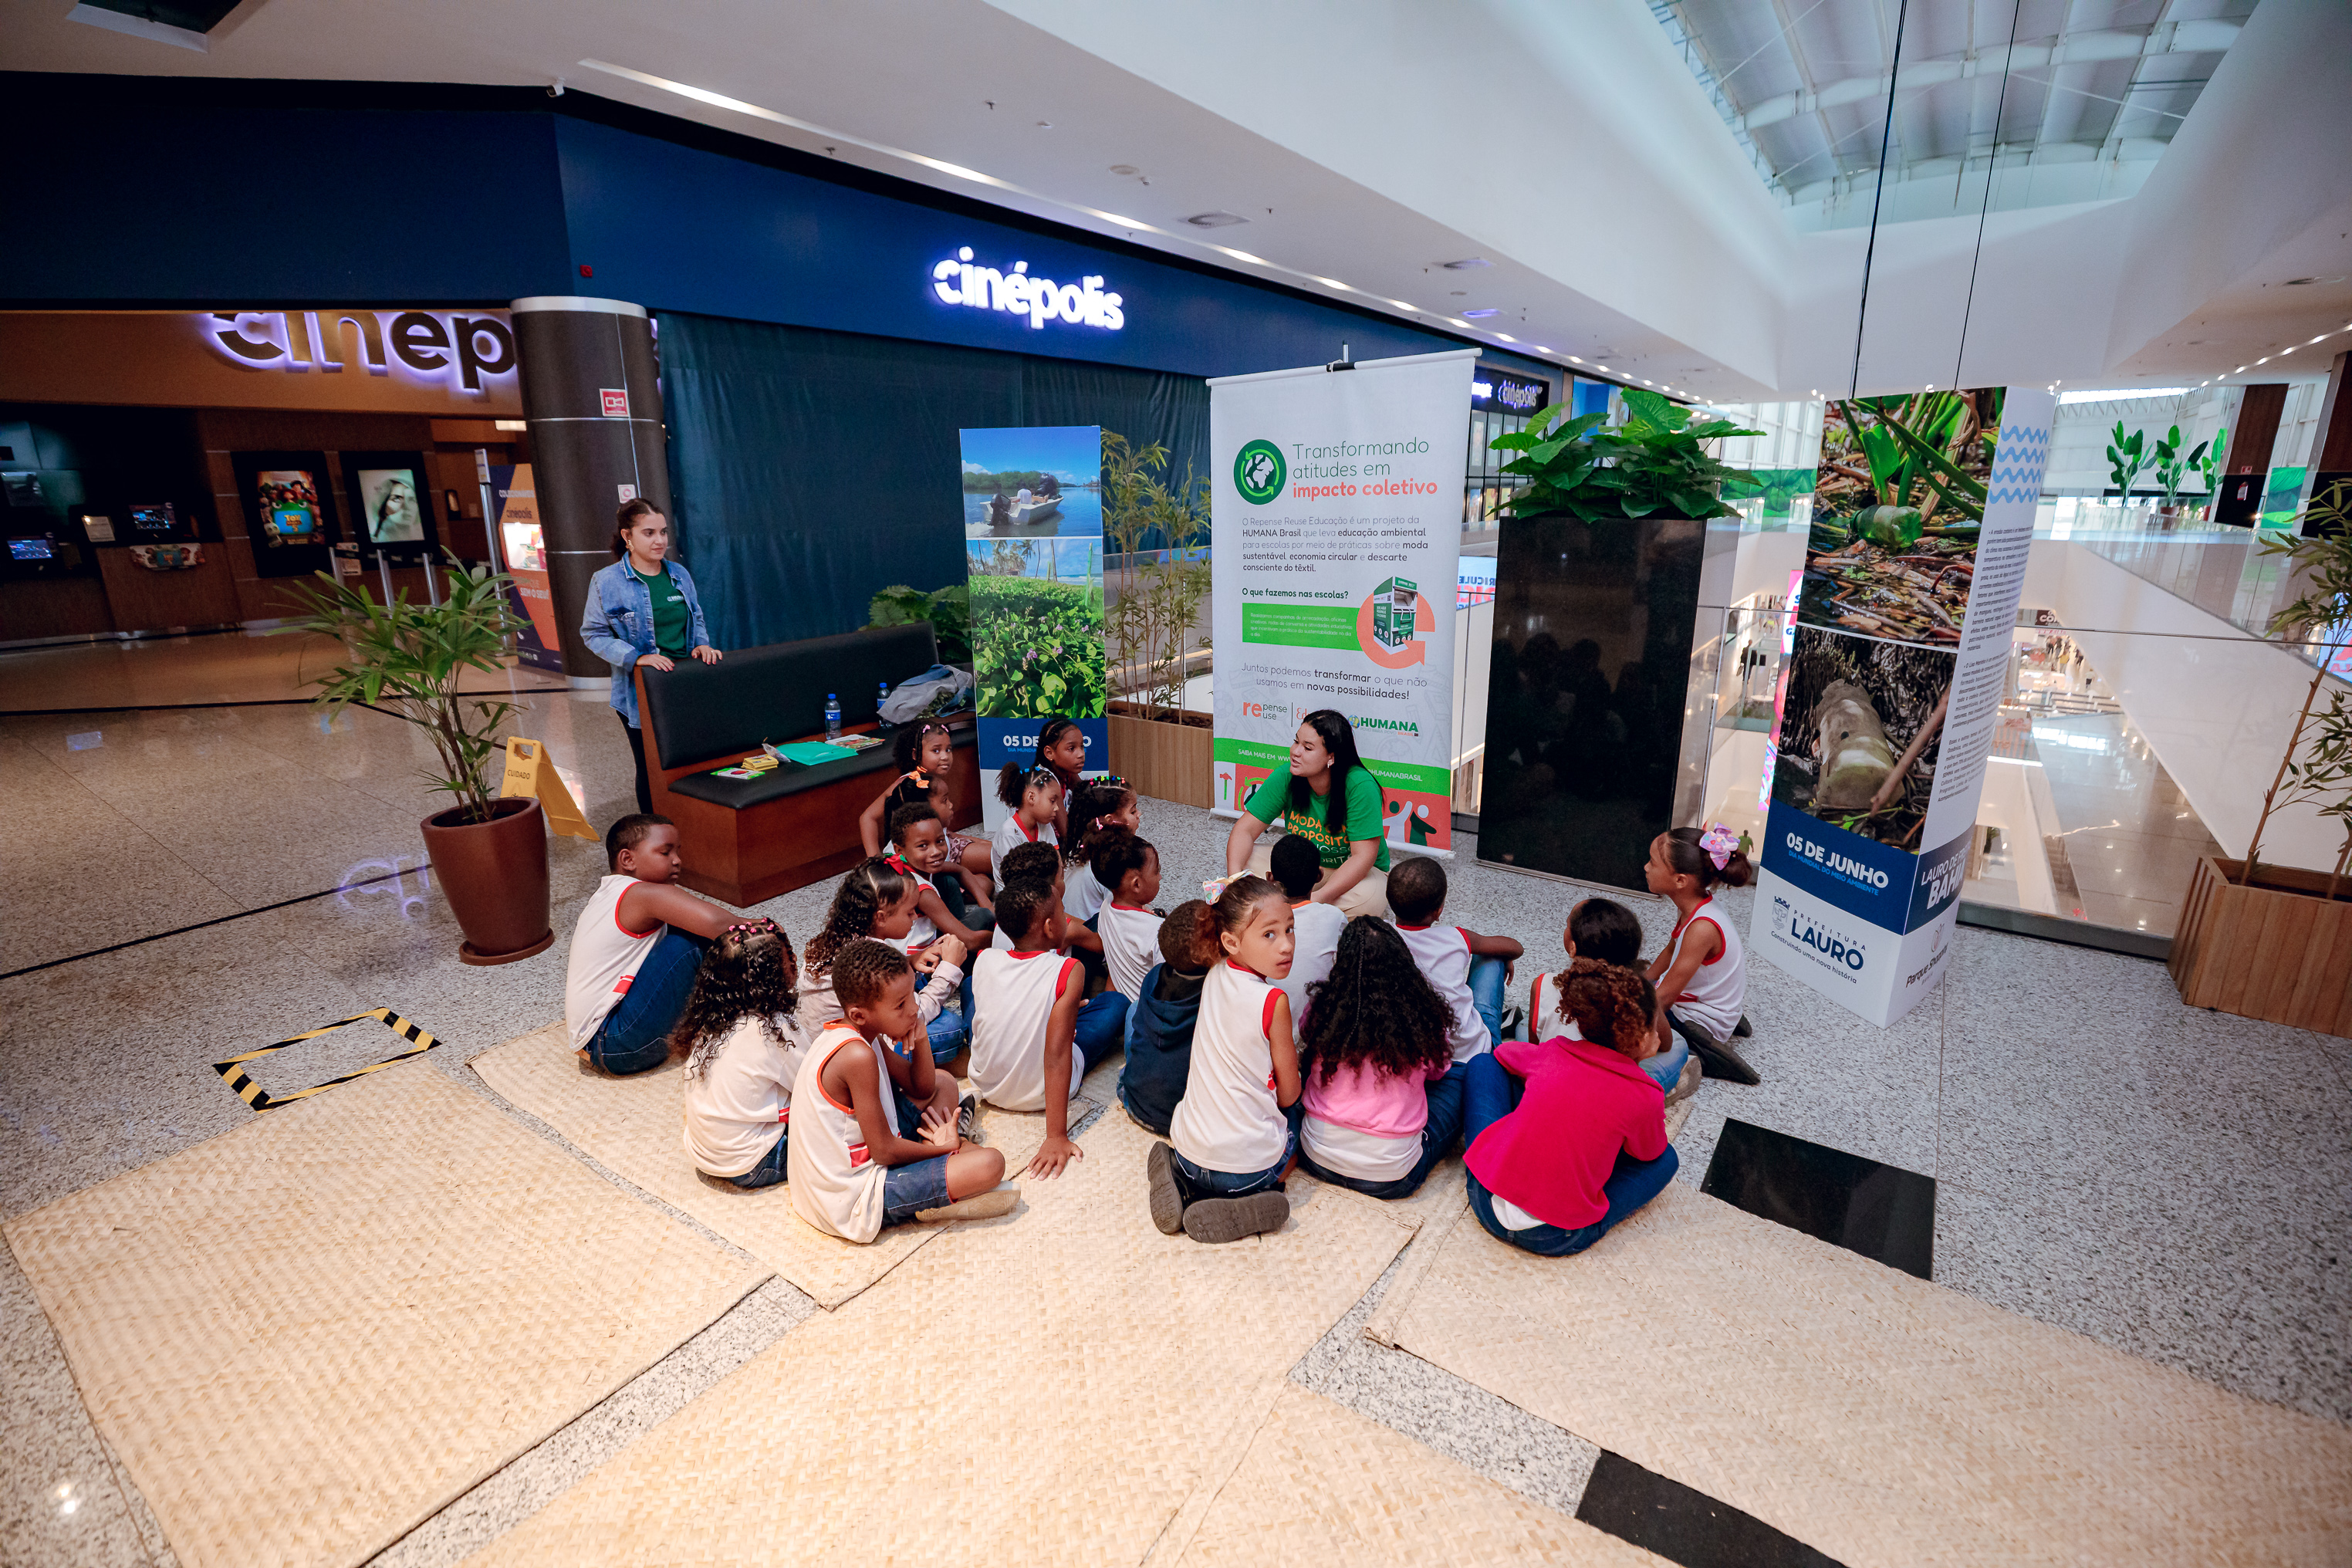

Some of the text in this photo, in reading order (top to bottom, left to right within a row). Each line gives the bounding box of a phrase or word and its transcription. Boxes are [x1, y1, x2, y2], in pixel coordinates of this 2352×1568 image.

[932, 245, 1124, 330] cinépolis
[1293, 437, 1429, 460] Transformando
[1293, 462, 1391, 479] atitudes em
[1293, 478, 1438, 501] impacto coletivo
[1251, 518, 1282, 527] Repense
[1284, 517, 1307, 525] Reuse
[1309, 516, 1347, 525] Educação
[1350, 516, 1354, 525] é
[1373, 515, 1405, 525] projeto
[1407, 515, 1420, 524] da
[1242, 527, 1426, 539] HUMANA Brasil que leva educação ambiental
[1242, 540, 1428, 551] para escolas por meio de práticas sobre moda
[1289, 553, 1326, 561] economia
[1328, 553, 1357, 562] circular
[1367, 553, 1407, 562] descarte
[1242, 563, 1282, 572] consciente
[1295, 563, 1316, 573] têxtil.
[1266, 588, 1296, 597] fazemos
[1314, 590, 1349, 599] escolas?
[1242, 663, 1269, 673] Juntos
[1270, 666, 1312, 677] podemos
[1314, 669, 1371, 683] transformar
[1384, 677, 1404, 687] que
[1407, 678, 1428, 687] não
[1256, 678, 1288, 688] usamos
[1307, 683, 1335, 693] novas
[1337, 685, 1410, 700] possibilidades!
[1243, 702, 1288, 718] re pense
[1360, 717, 1418, 732] HUMANA
[1003, 735, 1039, 747] 05 DE
[508, 769, 530, 779] CUIDADO
[1289, 811, 1322, 830] MODA
[1786, 832, 1889, 888] 05 DE JUNHO
[1921, 860, 1948, 886] LAURO
[1948, 854, 1958, 870] DE
[1789, 850, 1879, 896] DIA MUNDIAL DO MEIO AMBIENTE
[1794, 910, 1866, 951] PREFEITURA
[1791, 917, 1864, 971] LAURO
[1771, 931, 1857, 984] Construindo uma nova história
[1906, 965, 1928, 988] Parque
